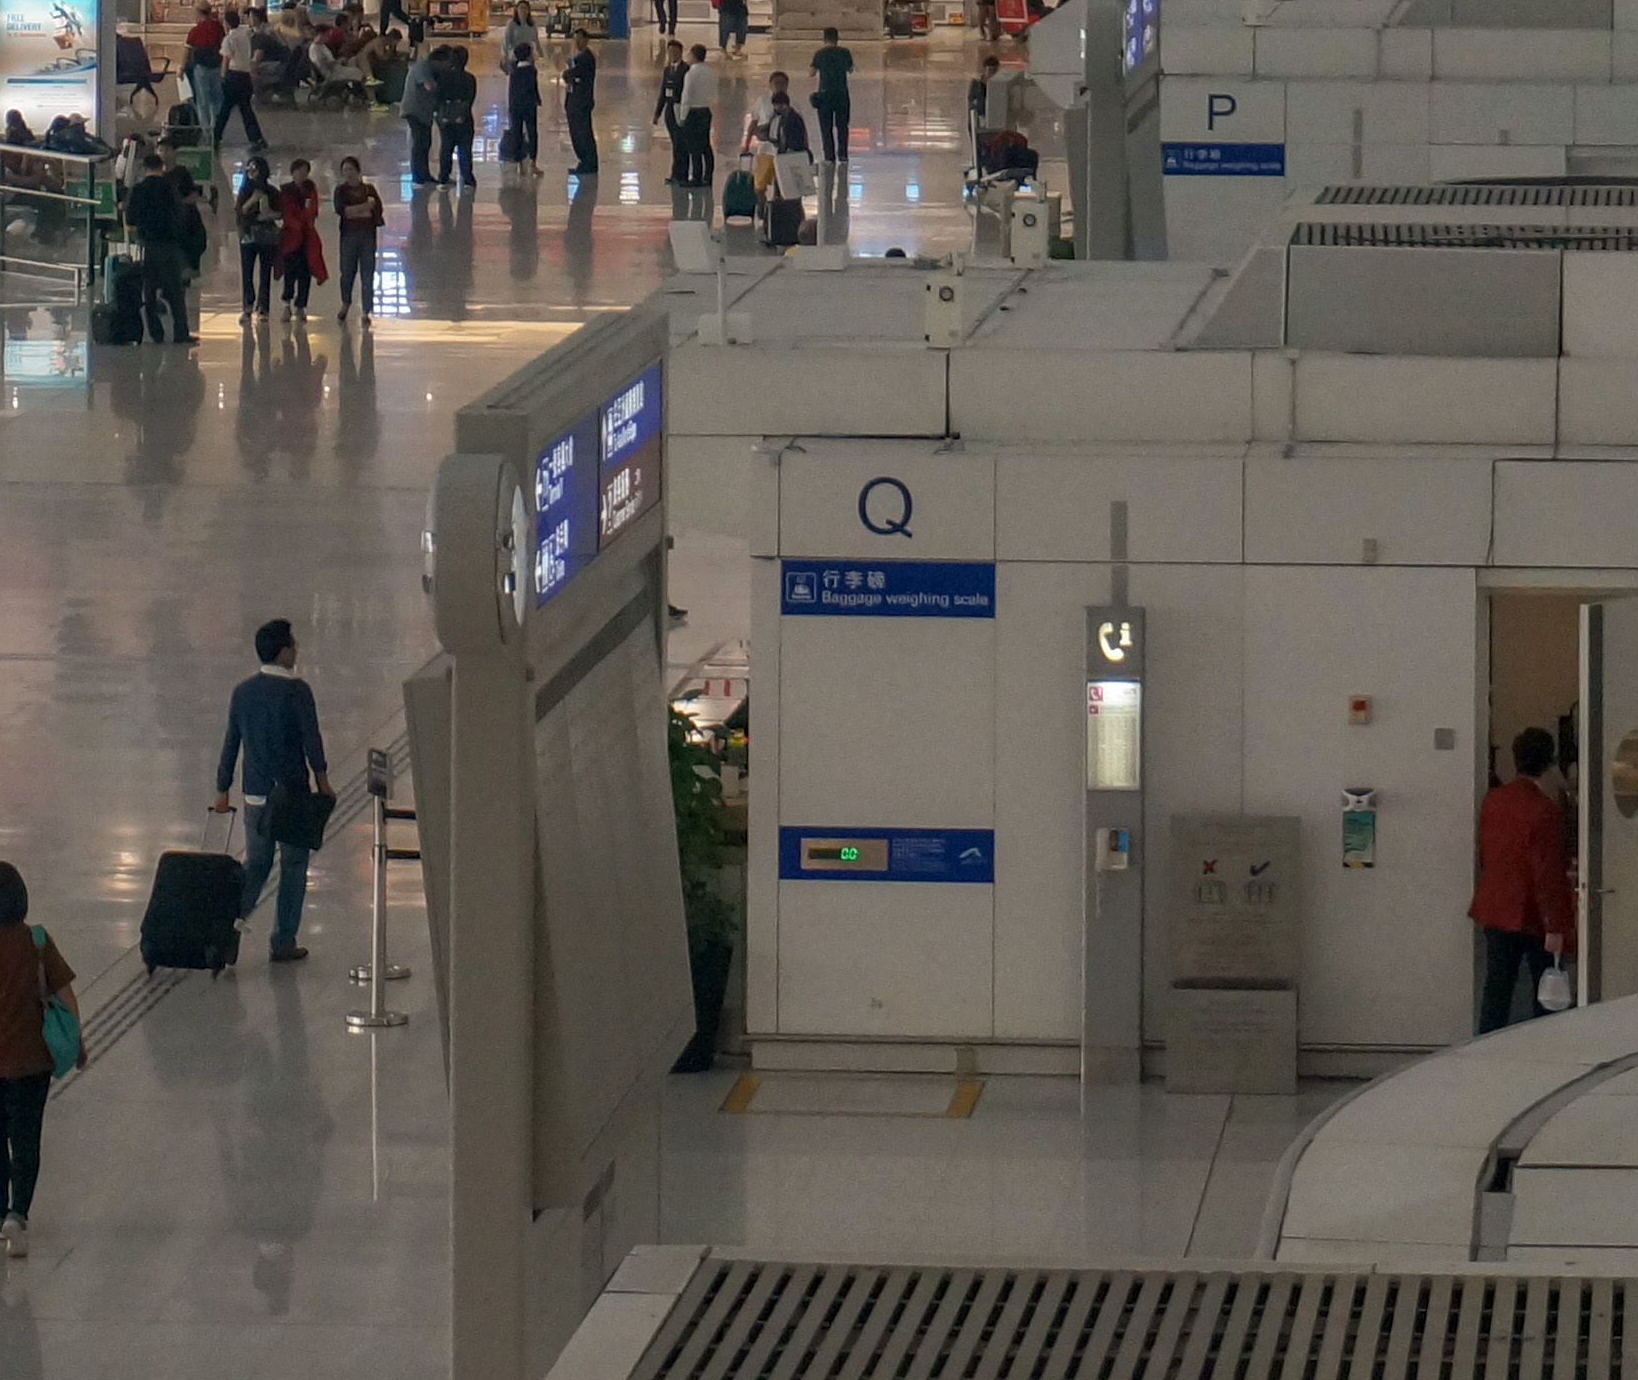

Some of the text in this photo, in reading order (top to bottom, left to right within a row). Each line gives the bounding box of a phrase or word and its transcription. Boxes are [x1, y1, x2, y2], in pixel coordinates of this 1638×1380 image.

[1208, 94, 1236, 131] P
[858, 477, 913, 538] Q
[822, 569, 886, 589] 行李磅
[821, 590, 989, 607] Baggage weighing scale
